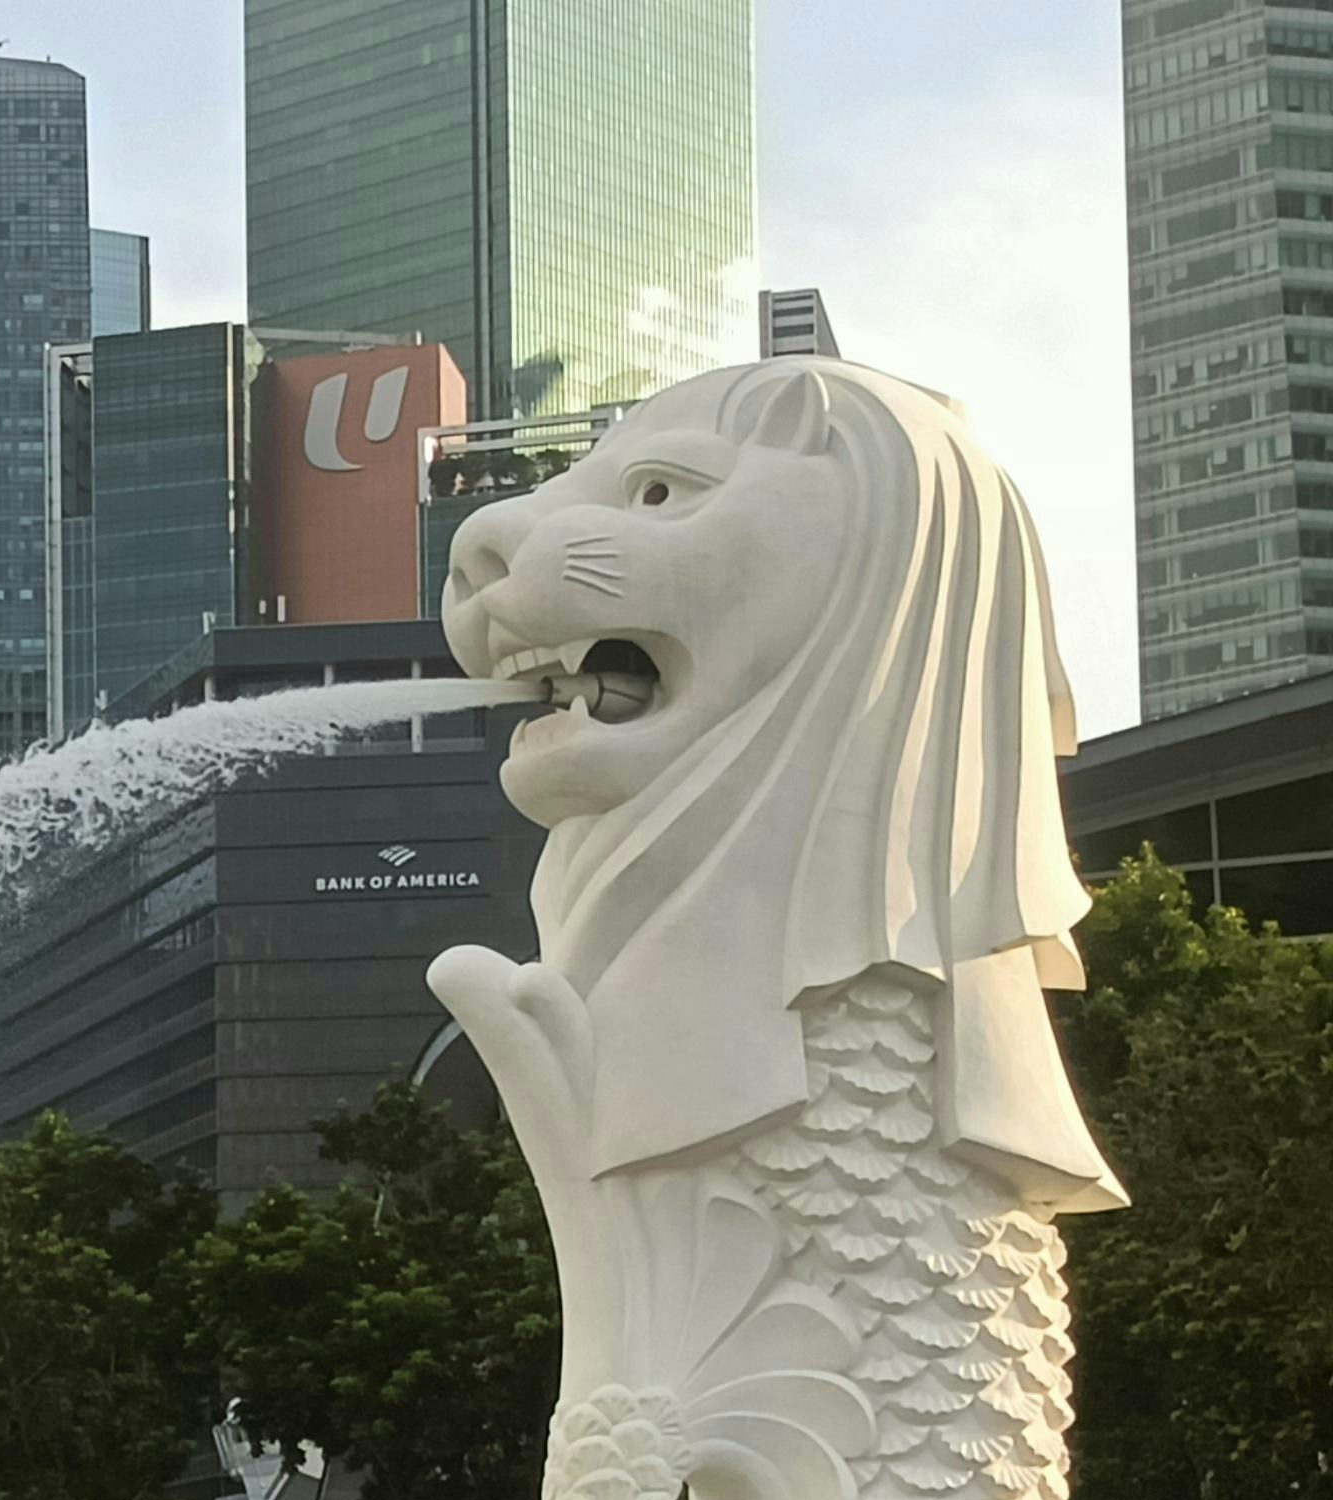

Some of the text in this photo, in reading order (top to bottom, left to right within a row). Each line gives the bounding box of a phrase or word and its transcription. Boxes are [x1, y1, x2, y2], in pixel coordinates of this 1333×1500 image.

[315, 872, 480, 891] BANK OF AMERICA
